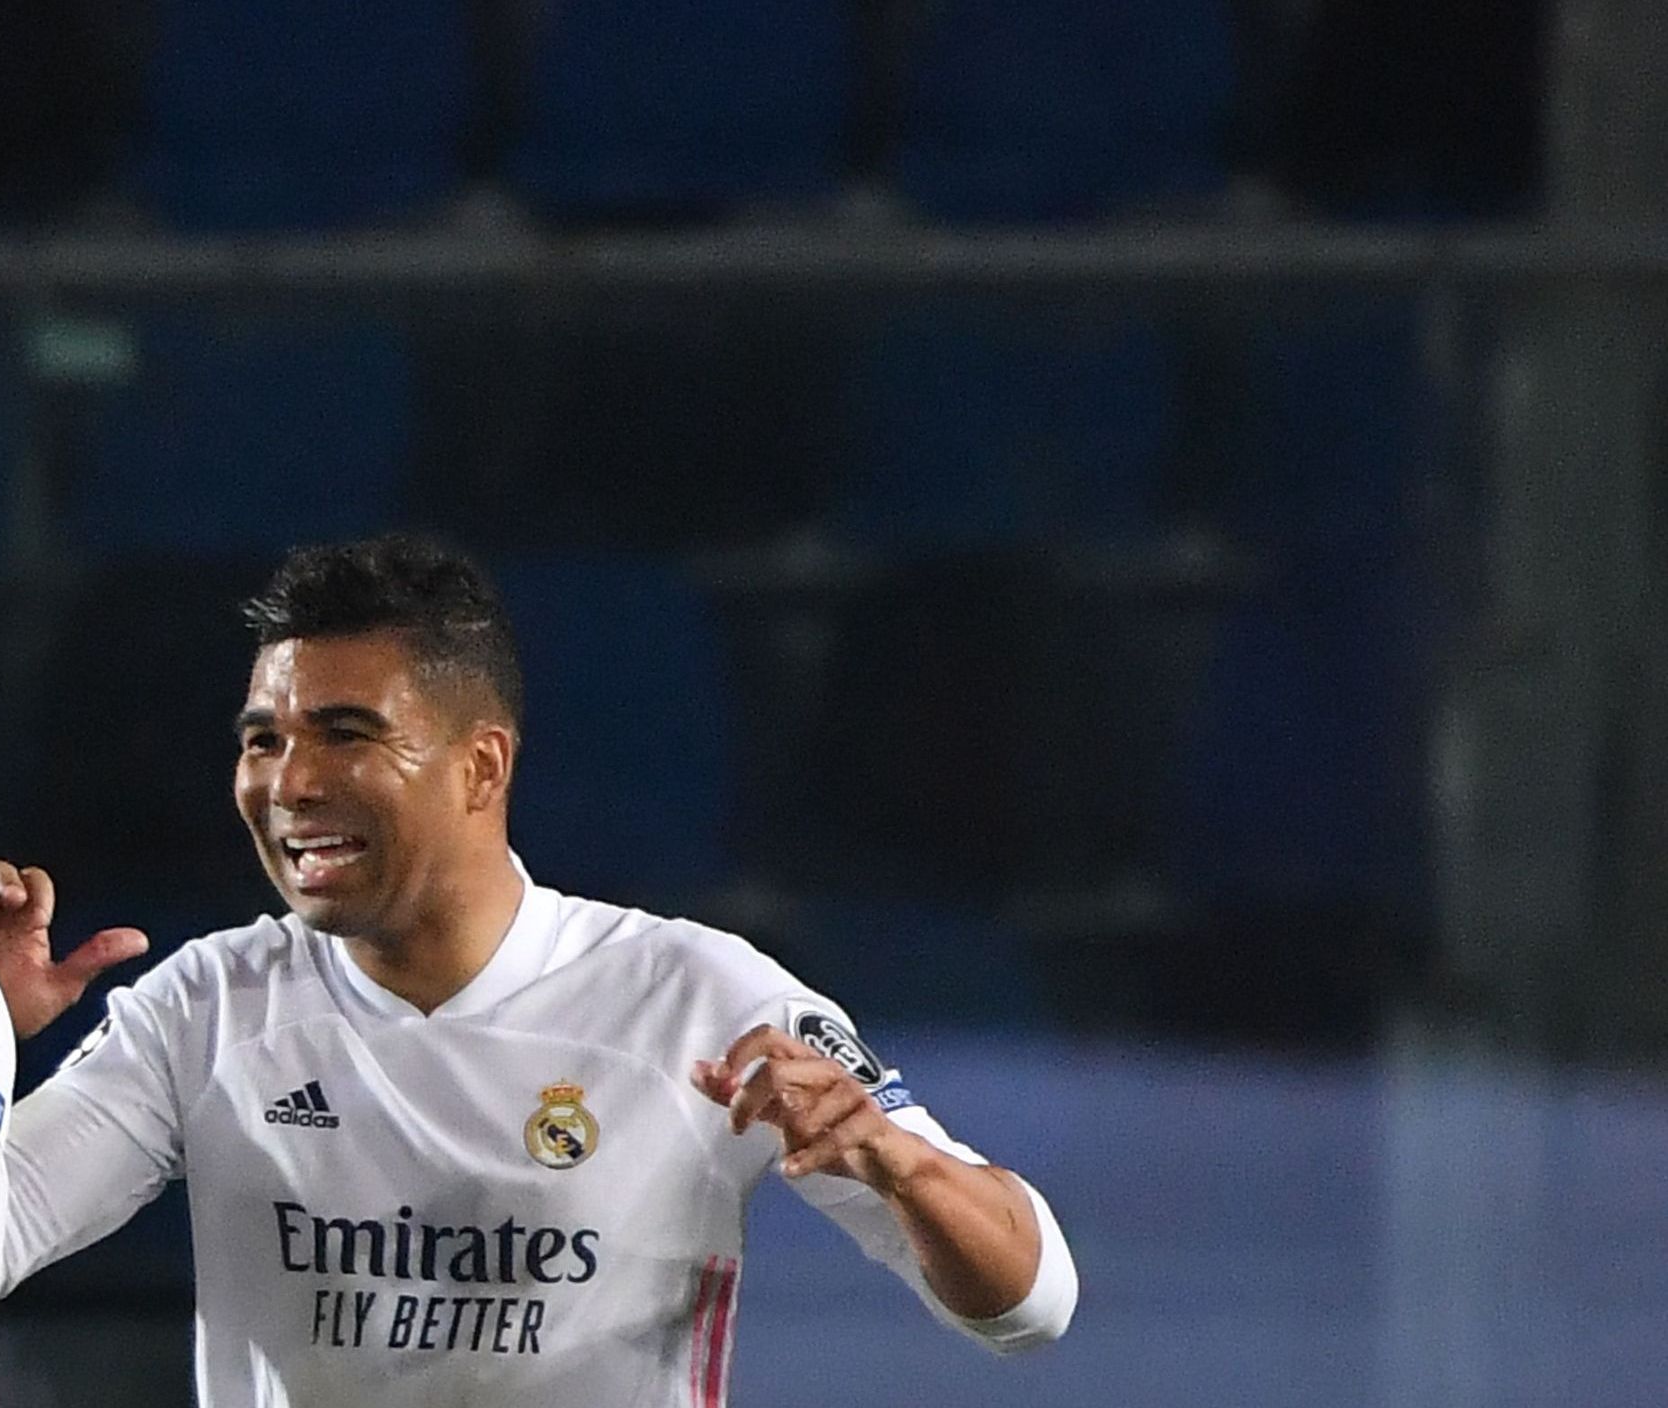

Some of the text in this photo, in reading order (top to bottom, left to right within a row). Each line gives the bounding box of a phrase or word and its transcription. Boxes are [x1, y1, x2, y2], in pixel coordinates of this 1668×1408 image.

[264, 1106, 340, 1130] adidas
[273, 1201, 600, 1284] Emirates
[311, 1289, 545, 1354] FLY BETTER
